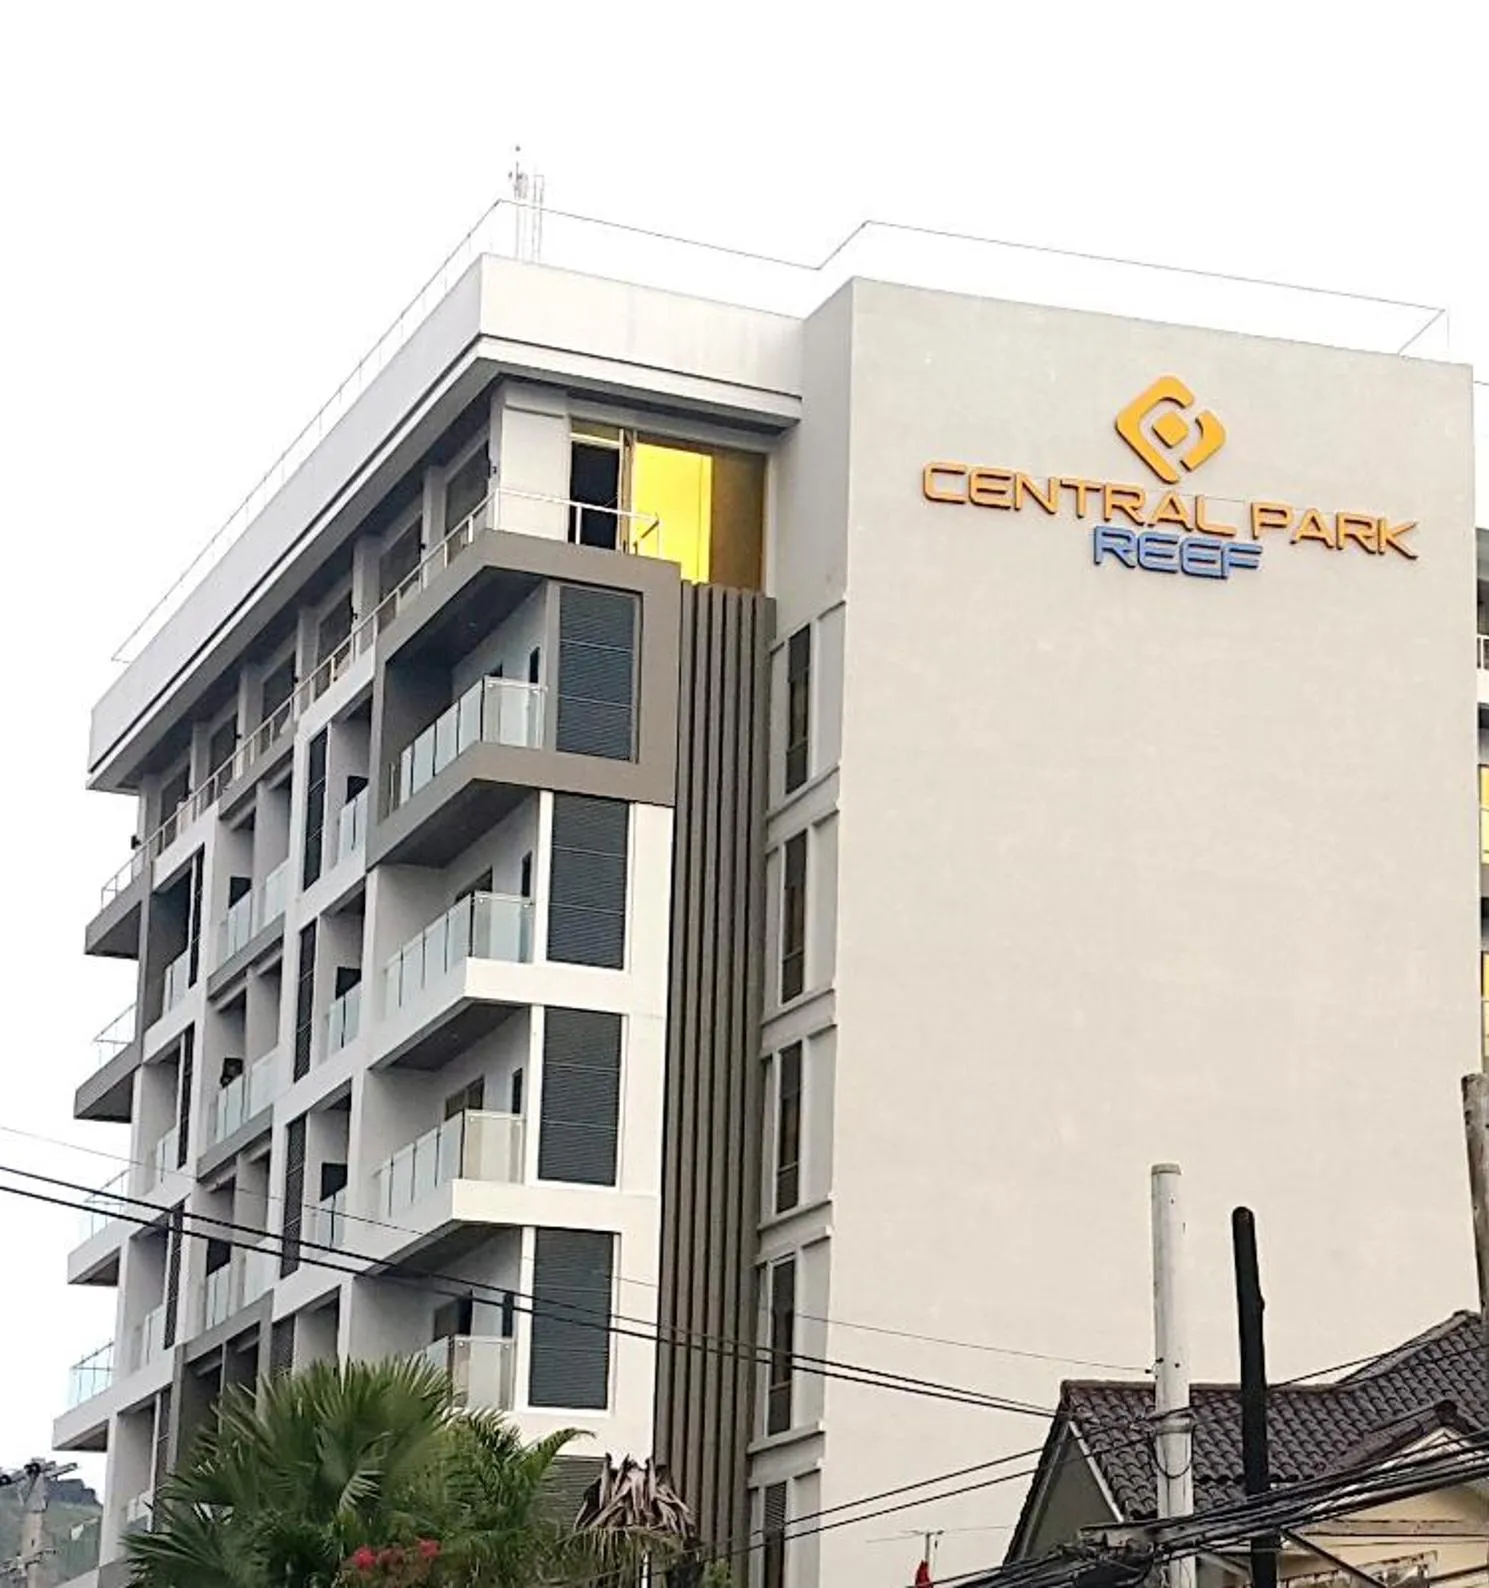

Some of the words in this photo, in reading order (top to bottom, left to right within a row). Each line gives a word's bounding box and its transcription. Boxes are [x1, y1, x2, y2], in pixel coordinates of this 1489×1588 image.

[923, 462, 1237, 537] CENTRAL
[1250, 500, 1419, 560] PARK
[1094, 525, 1263, 580] REEF
